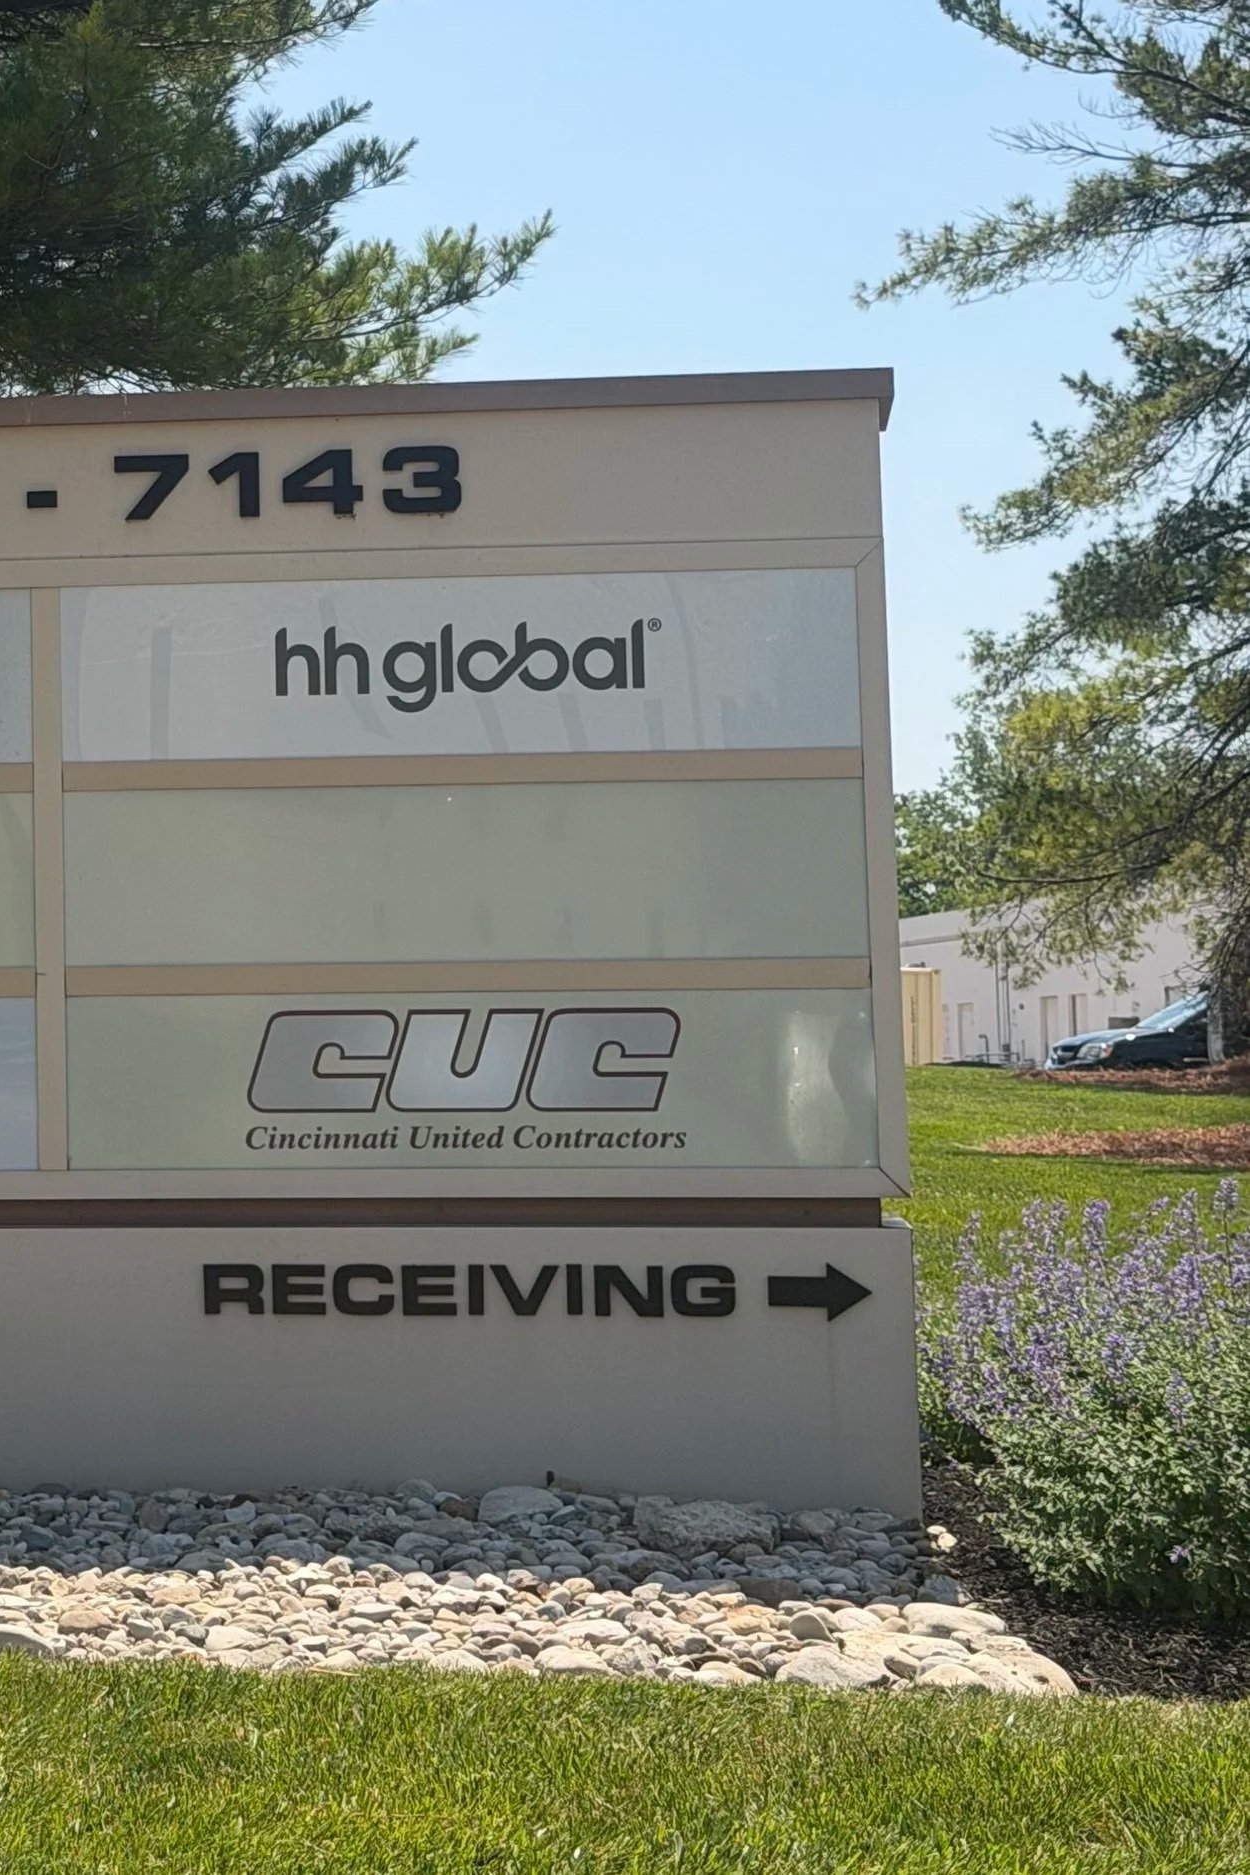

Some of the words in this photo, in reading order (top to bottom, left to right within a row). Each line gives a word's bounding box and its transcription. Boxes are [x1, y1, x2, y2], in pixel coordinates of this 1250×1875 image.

[114, 446, 462, 521] 7143
[248, 1008, 681, 1112] CUC
[246, 1126, 399, 1150] Cincinnati
[410, 1126, 505, 1150] United
[513, 1126, 687, 1150] Contractors
[203, 1264, 736, 1319] RECEIVING
